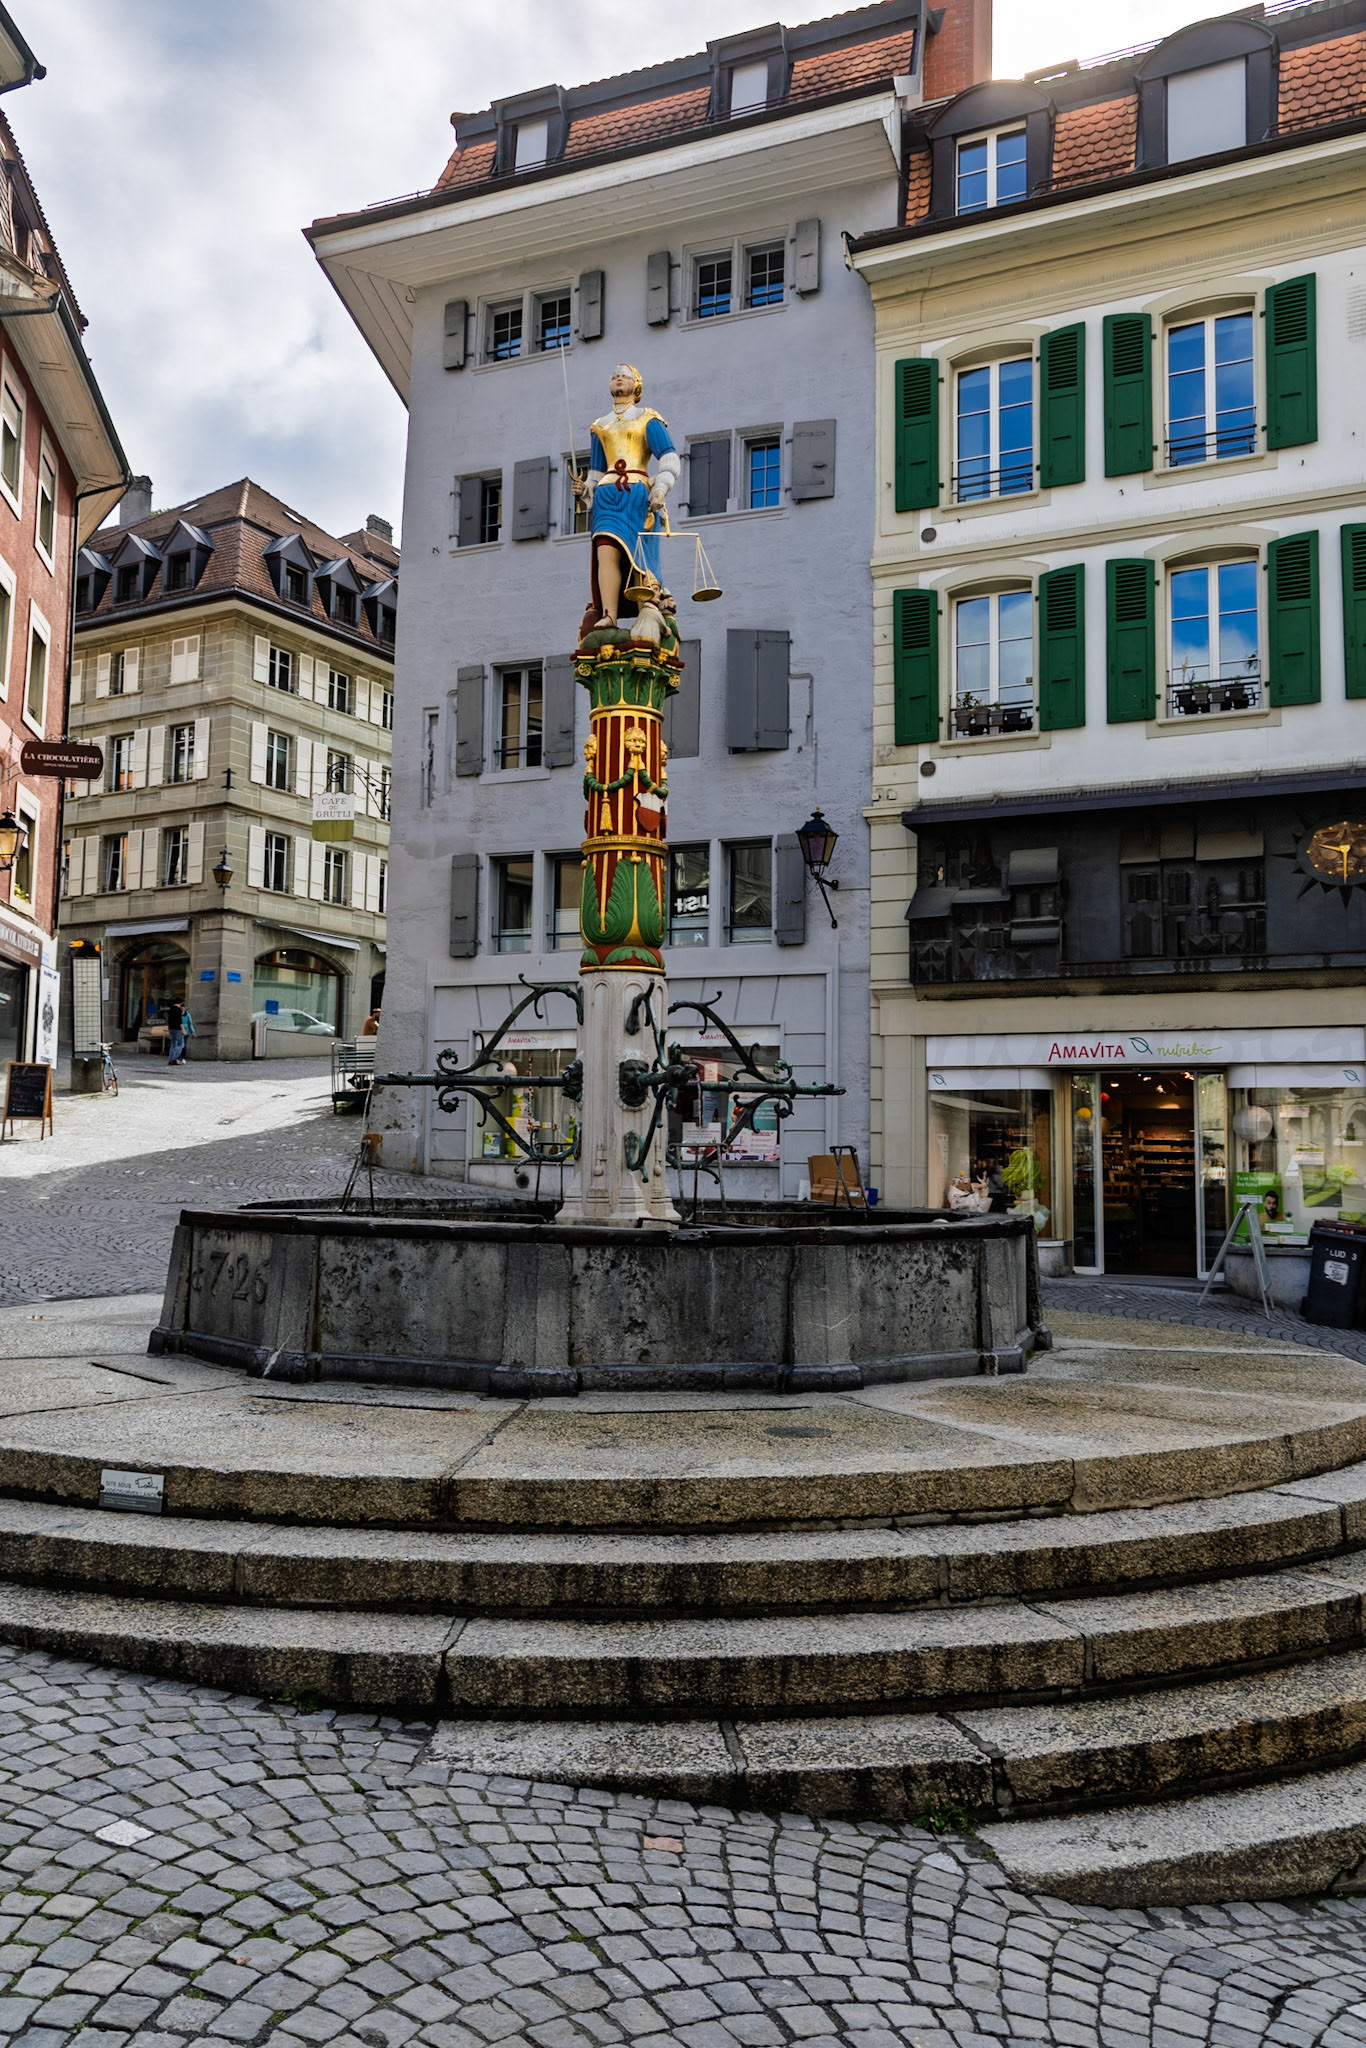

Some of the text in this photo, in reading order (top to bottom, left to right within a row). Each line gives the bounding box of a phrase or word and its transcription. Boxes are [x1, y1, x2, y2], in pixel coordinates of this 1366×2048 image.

[24, 752, 100, 765] LA CHOCOLATIÈRE
[507, 1036, 532, 1045] AMAVITA
[700, 1032, 726, 1041] AMAVITA
[1048, 1041, 1223, 1062] AMAVITA nutribio
[1351, 1252, 1358, 1261] 3
[105, 1480, 117, 1488] SITE
